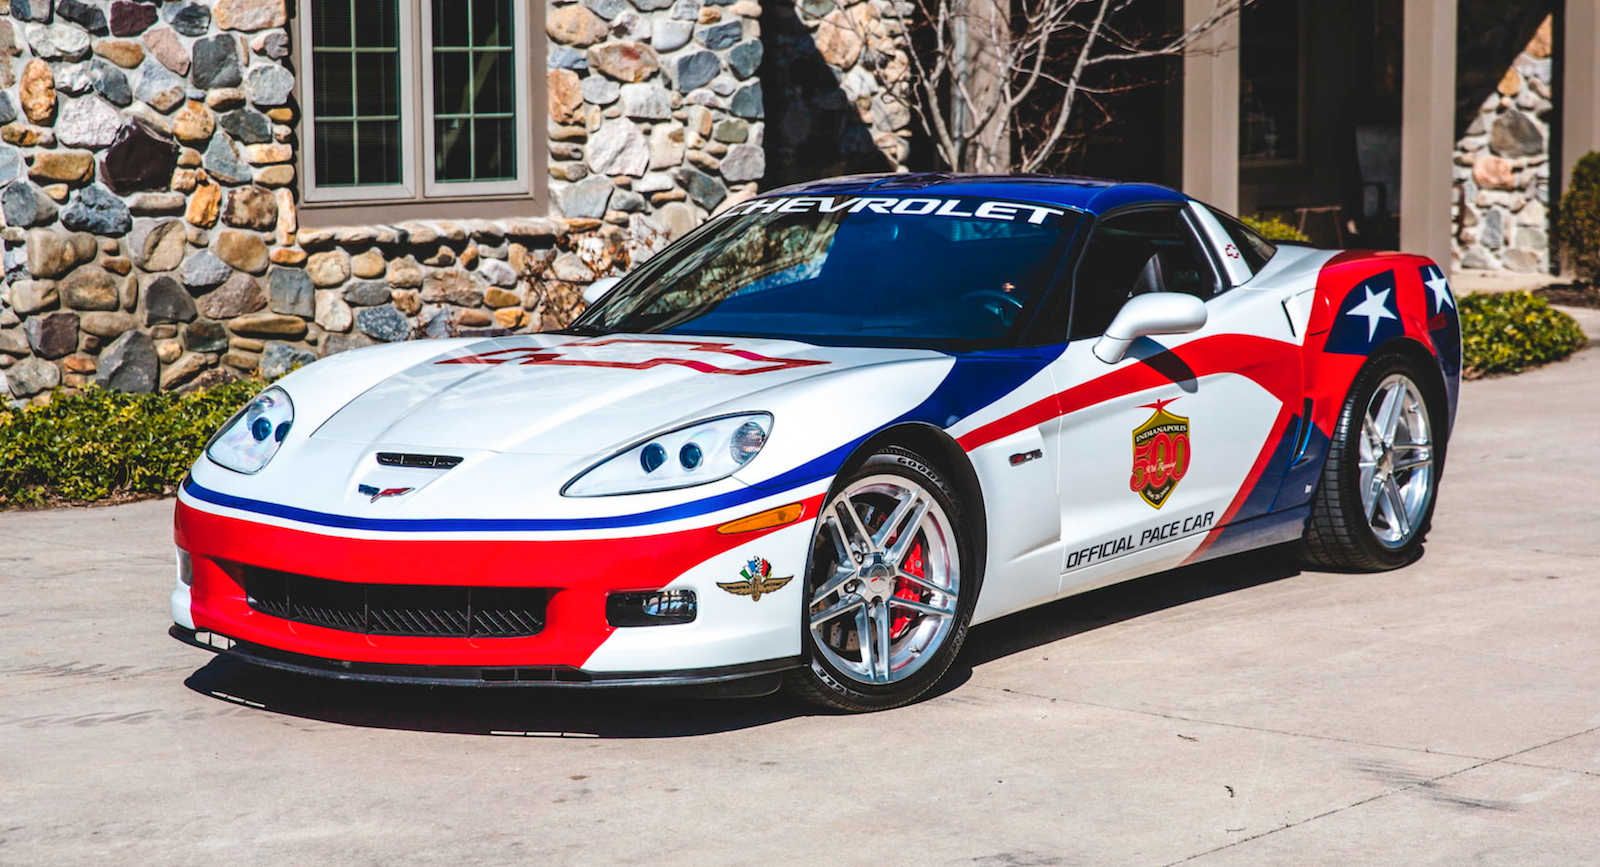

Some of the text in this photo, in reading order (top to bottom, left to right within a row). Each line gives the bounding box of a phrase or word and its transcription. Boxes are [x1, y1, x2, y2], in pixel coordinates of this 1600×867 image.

[720, 196, 1065, 225] CHEVROLET
[1135, 424, 1187, 442] INDIANAPOLIS
[1130, 432, 1190, 492] 500
[1066, 511, 1215, 569] OFFICIAL PACE CAR
